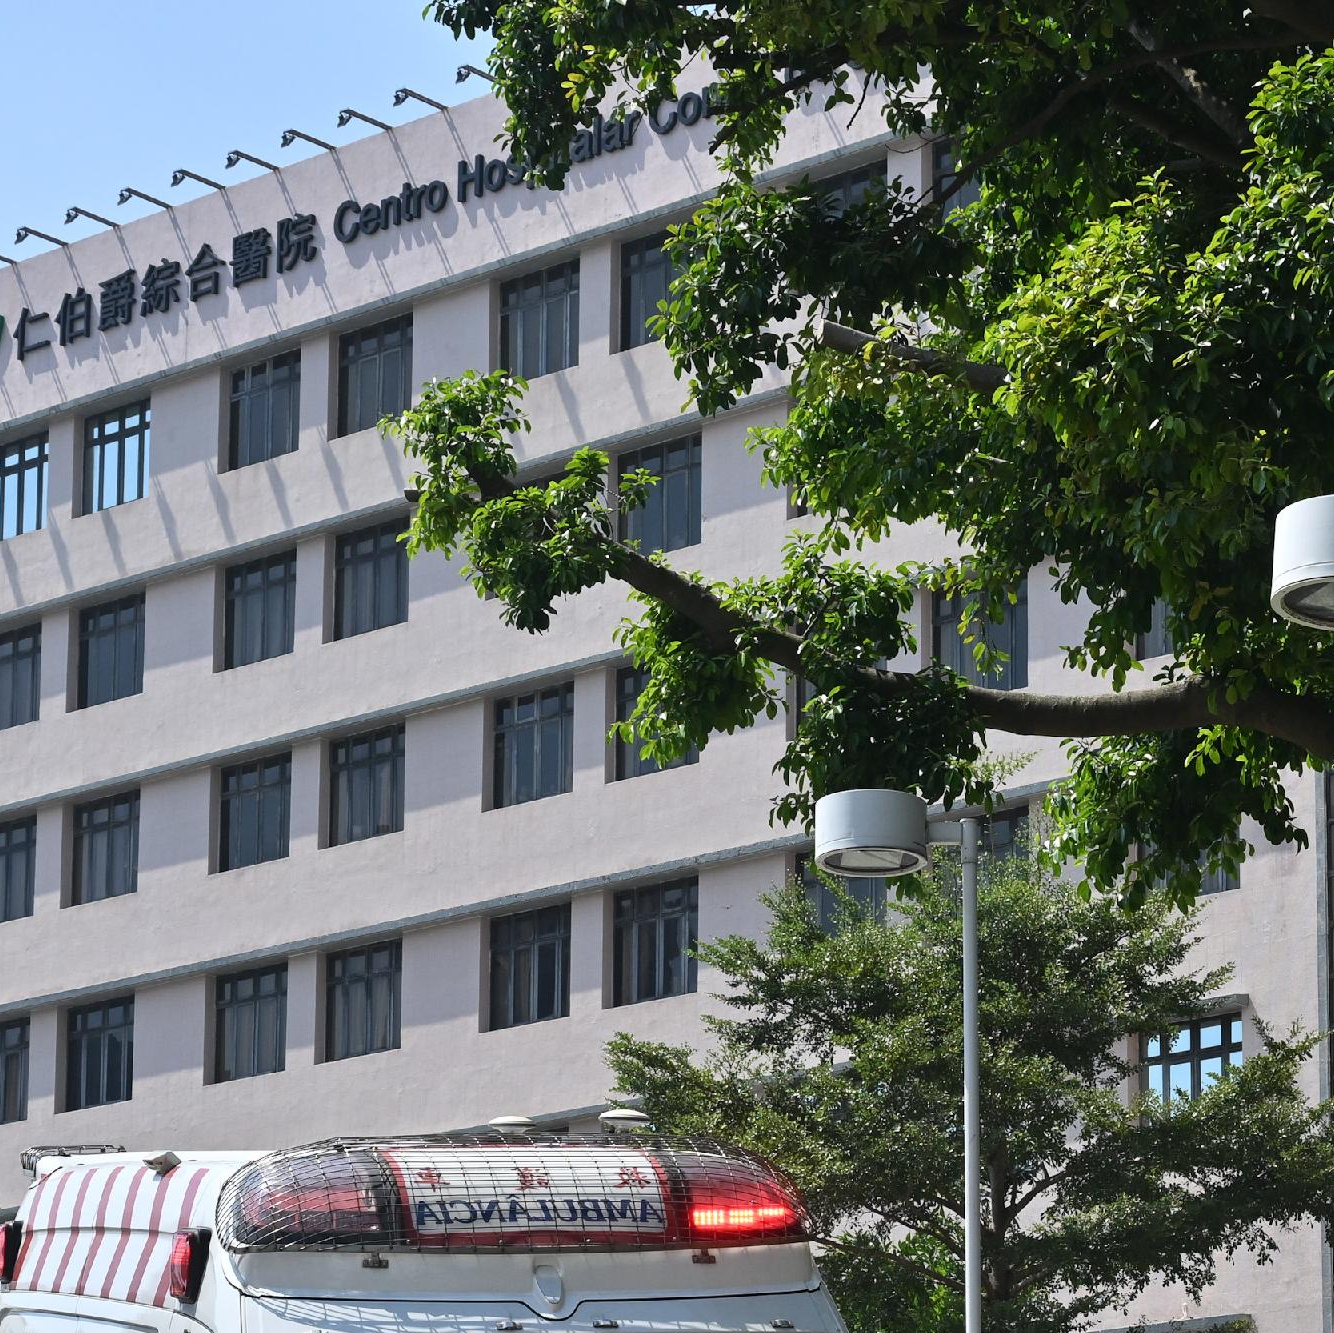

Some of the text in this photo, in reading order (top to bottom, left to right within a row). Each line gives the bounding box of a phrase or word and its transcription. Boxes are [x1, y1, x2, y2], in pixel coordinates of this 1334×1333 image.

[333, 177, 450, 245] Centro
[456, 109, 646, 204] Hosalar
[12, 213, 318, 362] 仁伯爵綜合醫院
